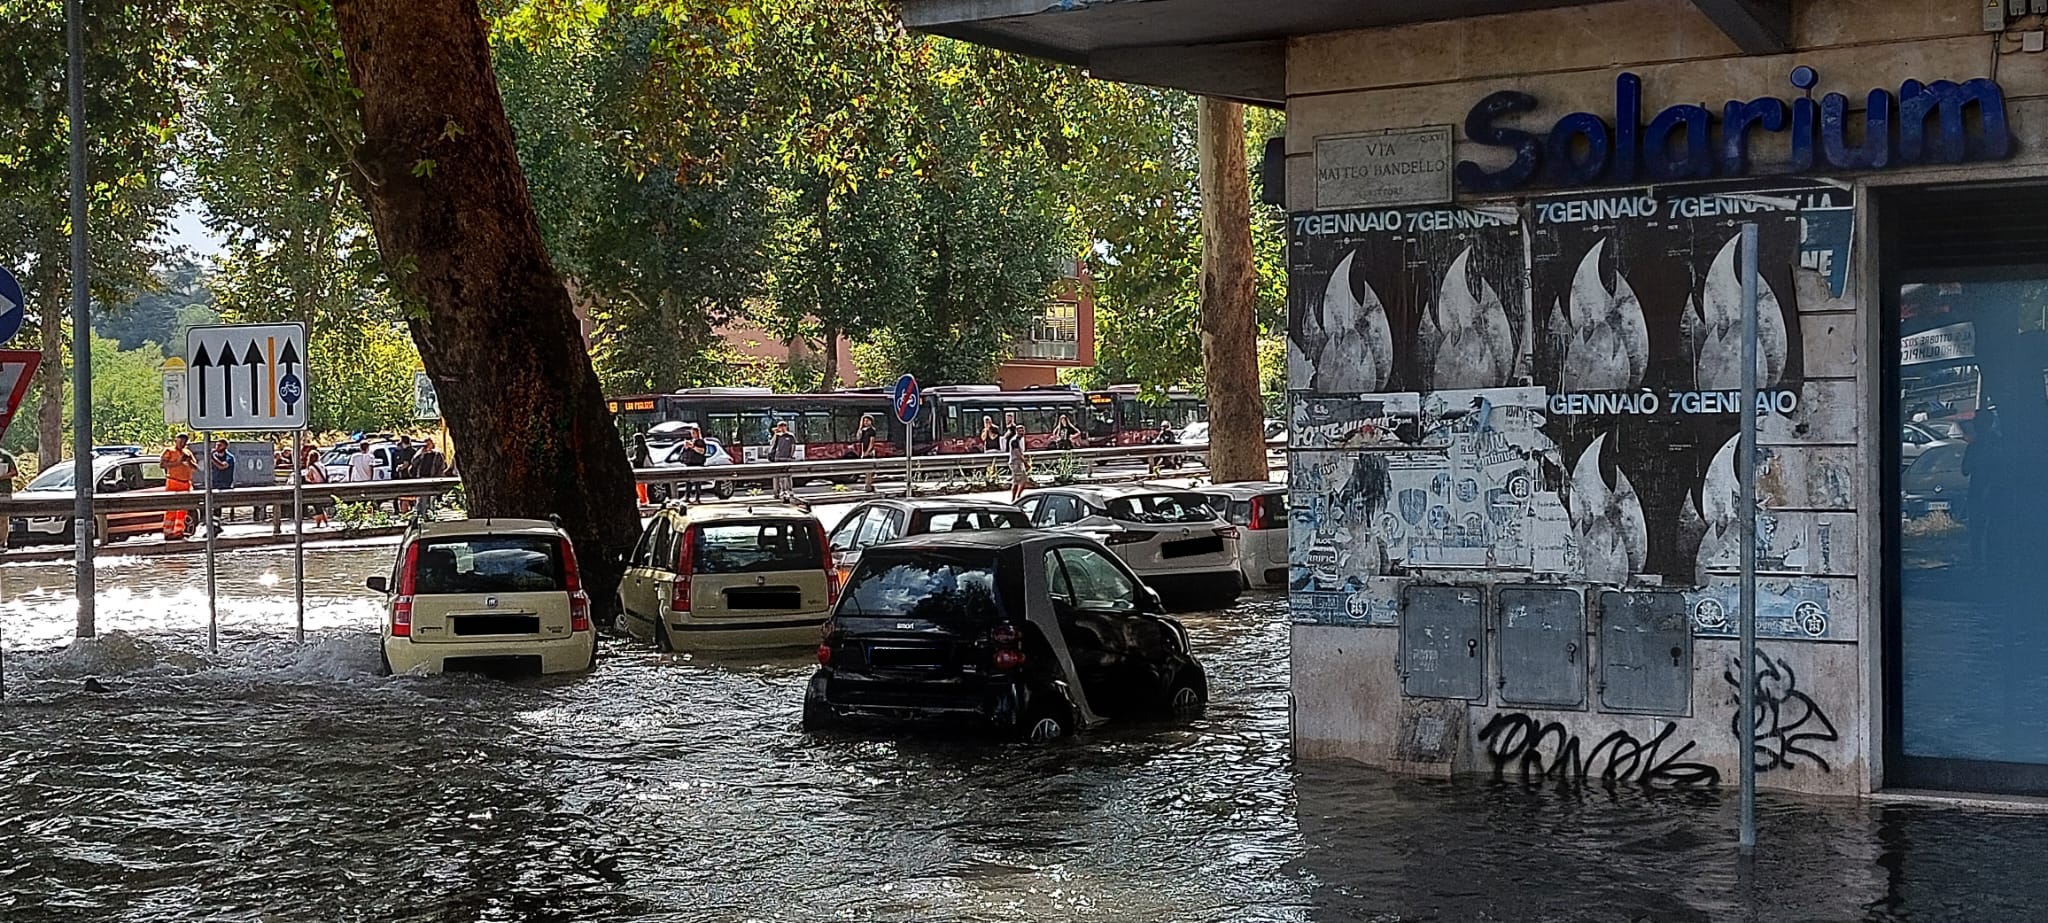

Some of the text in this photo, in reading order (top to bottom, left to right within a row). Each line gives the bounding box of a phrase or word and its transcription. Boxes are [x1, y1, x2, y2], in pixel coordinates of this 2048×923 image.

[1456, 66, 2010, 192] Solarium
[1366, 144, 1396, 157] VIA
[1318, 160, 1446, 181] MATTEO BANDELLO
[1294, 211, 1401, 236] 7GENNAIO
[1536, 198, 1657, 224] 7GENNAIO
